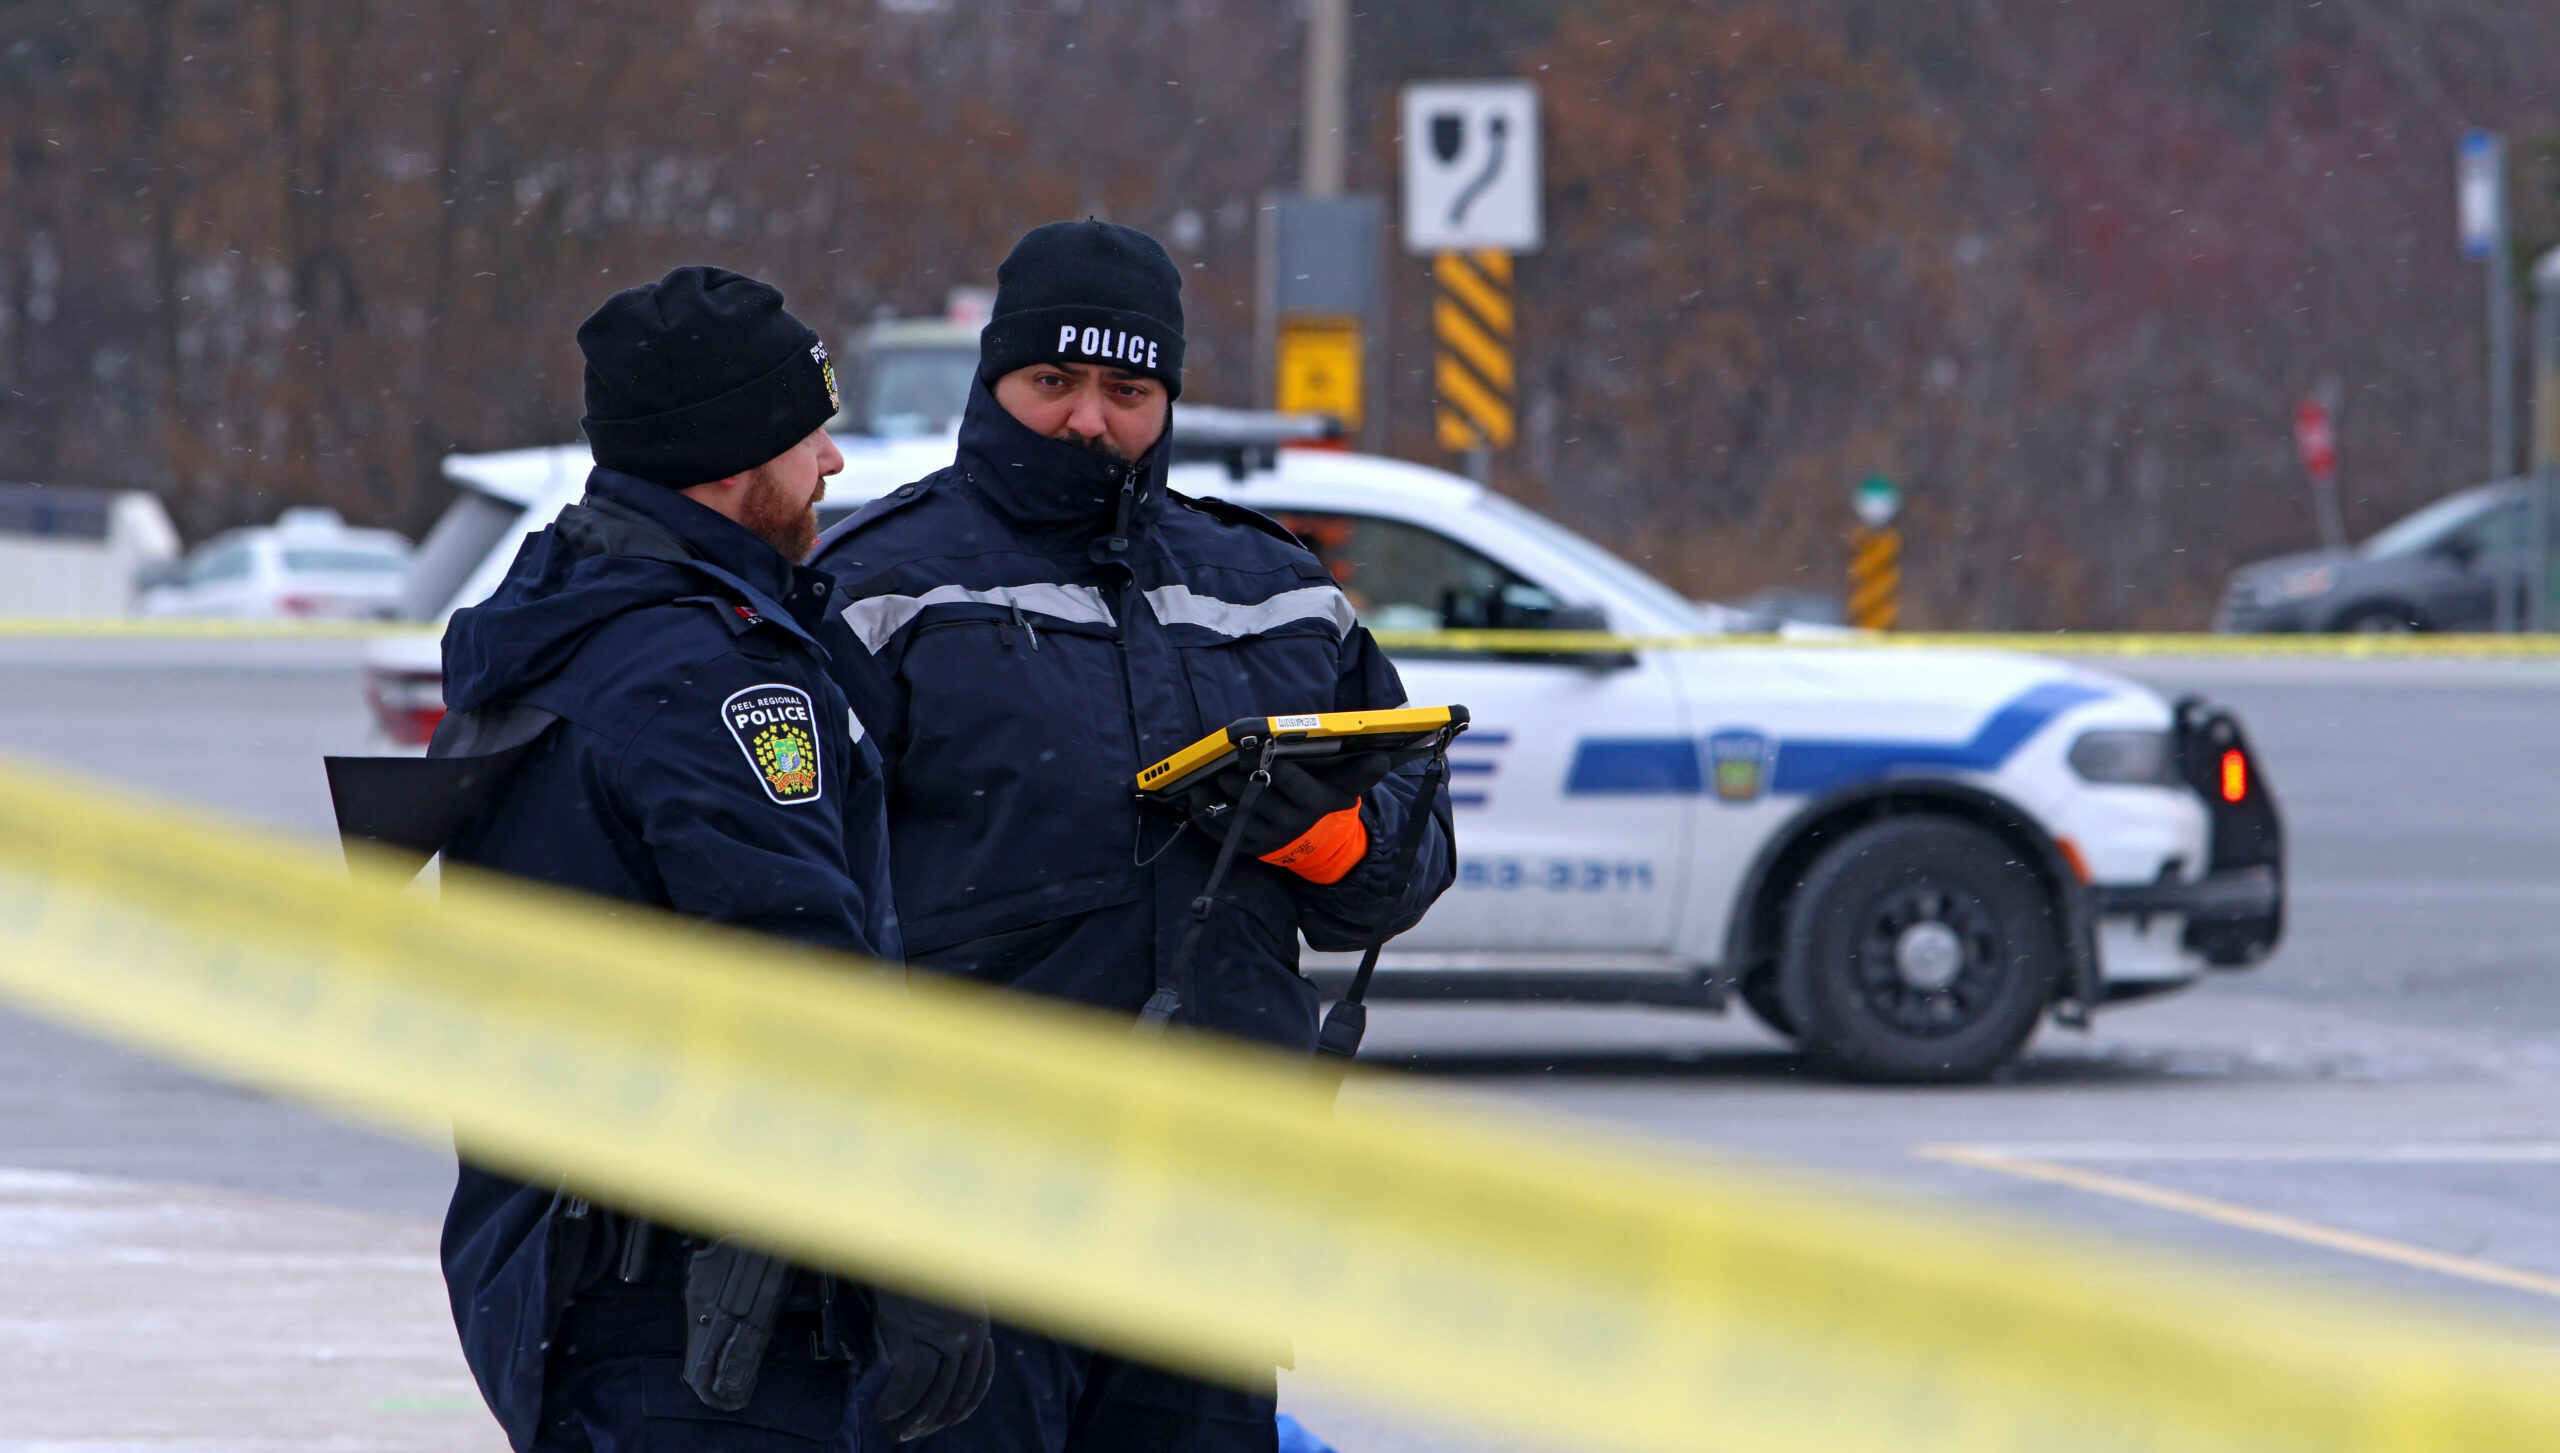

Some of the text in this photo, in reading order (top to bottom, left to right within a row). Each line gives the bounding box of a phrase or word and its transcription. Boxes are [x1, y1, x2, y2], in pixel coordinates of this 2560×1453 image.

[1057, 325, 1158, 369] POLICE
[730, 696, 802, 713] PEEL REGIONAL
[735, 706, 808, 729] POLICE
